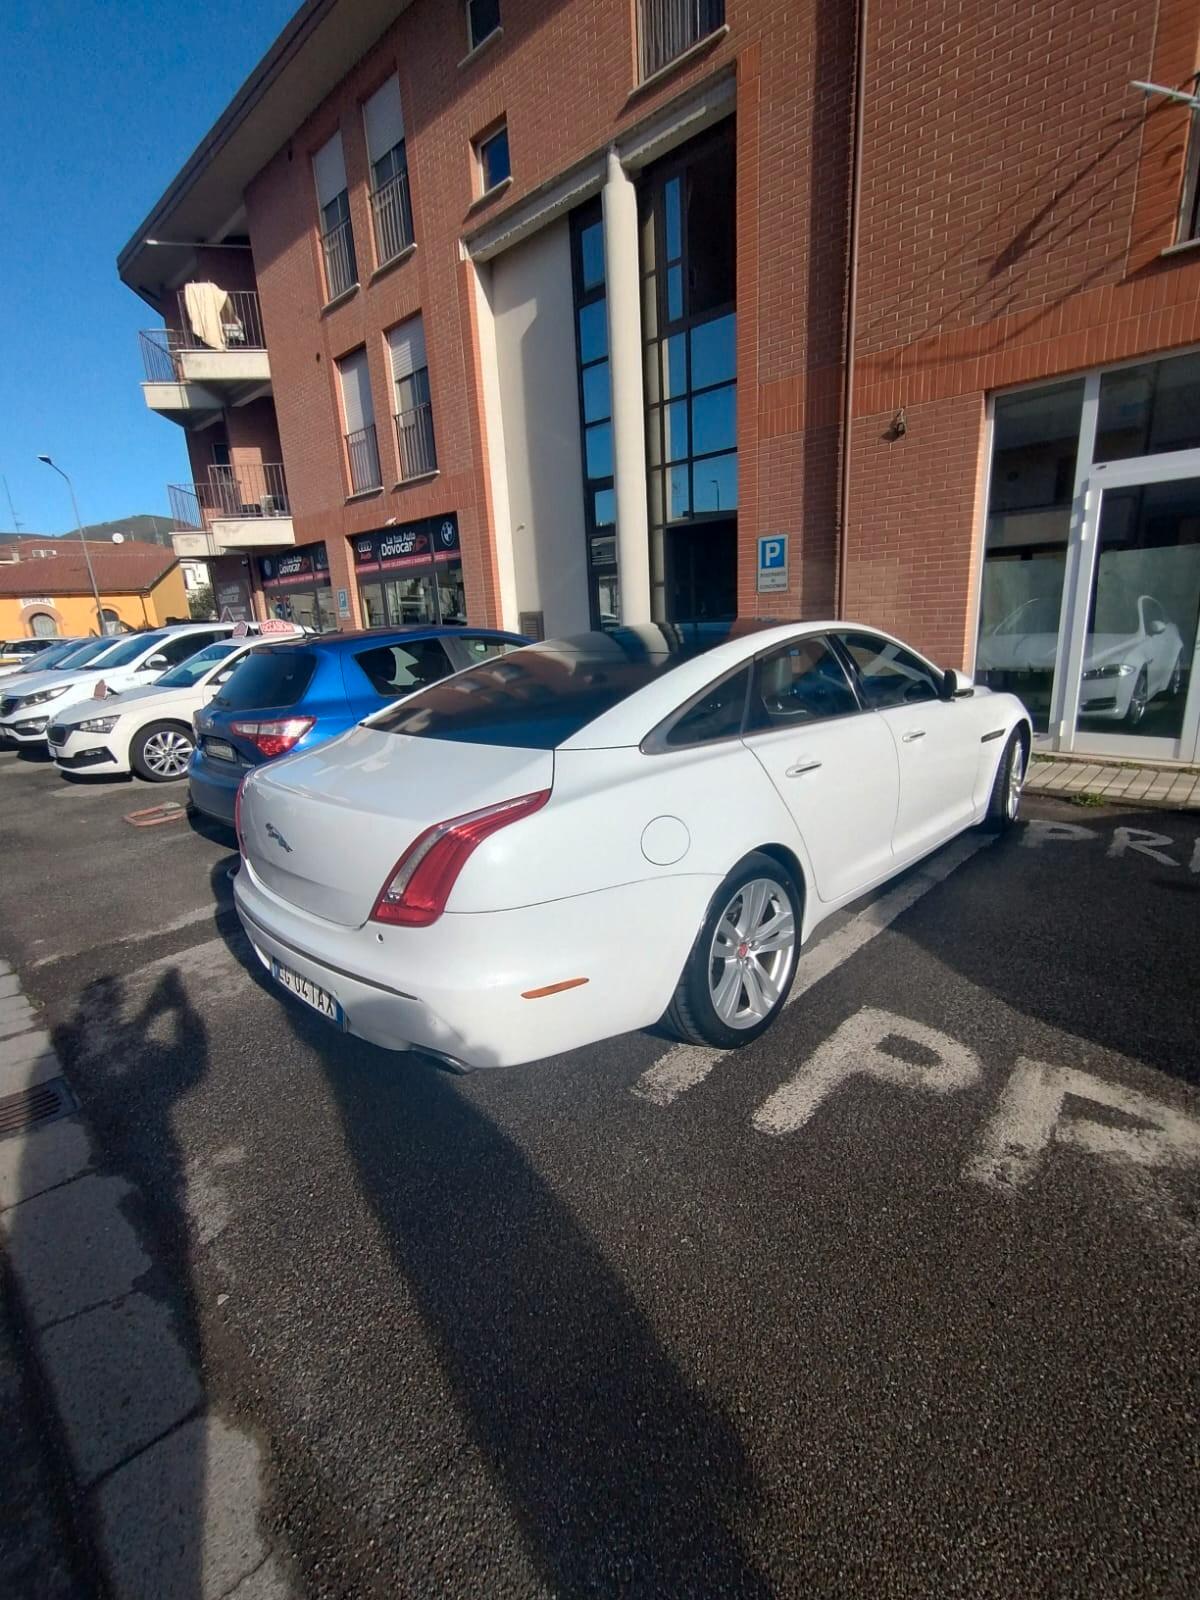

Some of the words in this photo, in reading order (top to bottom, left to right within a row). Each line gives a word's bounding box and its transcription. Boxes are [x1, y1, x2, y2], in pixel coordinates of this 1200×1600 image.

[386, 536, 393, 545] La
[403, 531, 416, 541] Auto
[381, 541, 413, 556] Dovocar
[765, 542, 780, 567] P
